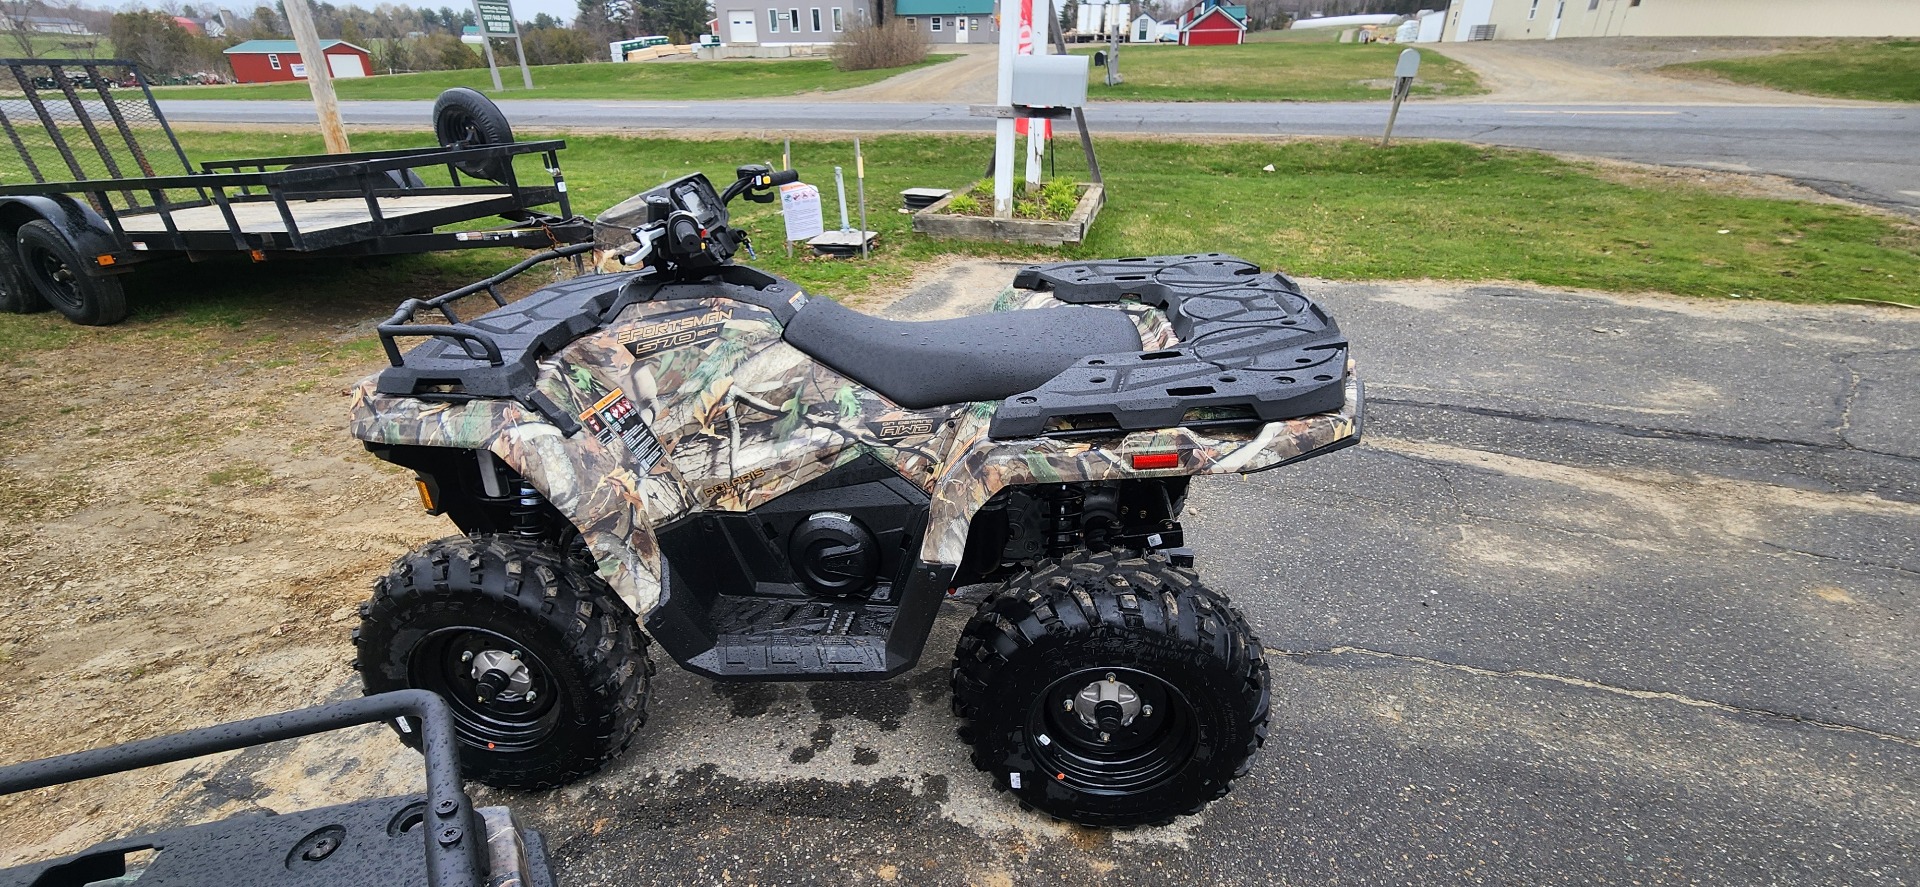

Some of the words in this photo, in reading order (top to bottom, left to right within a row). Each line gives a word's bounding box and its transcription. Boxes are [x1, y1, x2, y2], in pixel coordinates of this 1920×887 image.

[617, 309, 733, 344] SPORTSMAN
[636, 330, 696, 354] 570
[880, 424, 932, 436] AWD
[704, 466, 766, 498] POLARIS
